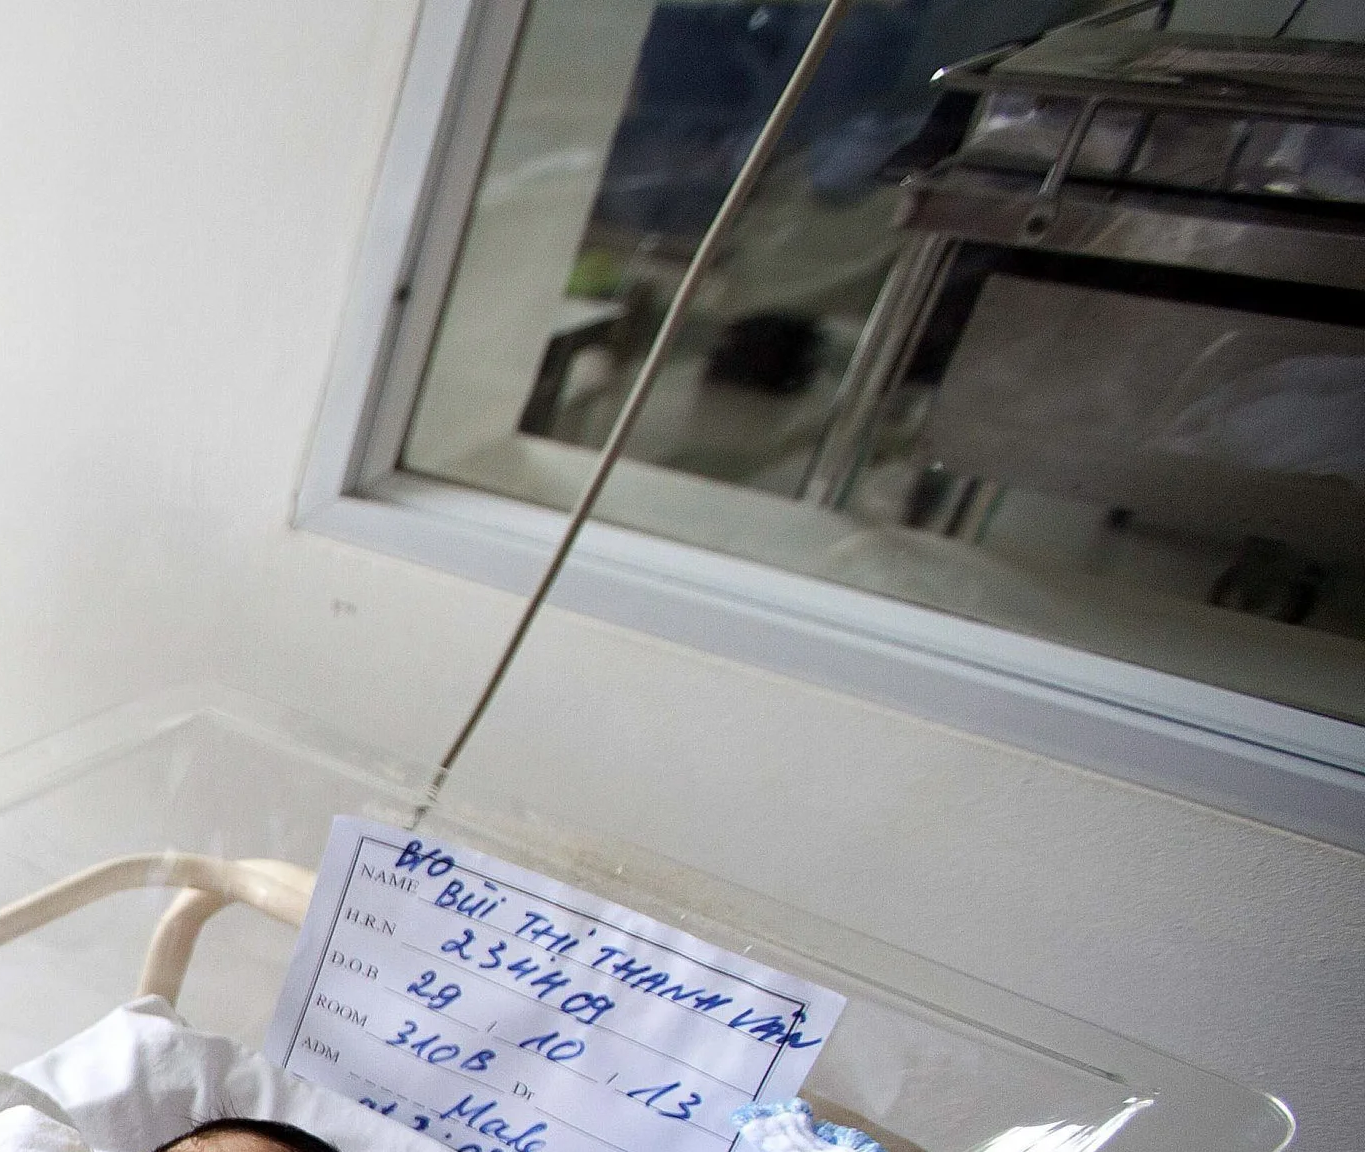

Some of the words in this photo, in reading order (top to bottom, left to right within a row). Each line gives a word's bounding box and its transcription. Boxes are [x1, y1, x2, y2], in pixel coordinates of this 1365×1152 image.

[361, 863, 419, 893] NAME
[302, 1036, 340, 1064] ADM
[316, 993, 368, 1027] ROOM
[513, 1080, 535, 1100] Dr
[330, 951, 379, 979] D.O.B
[519, 1031, 585, 1061] 10
[627, 1081, 702, 1120] 13
